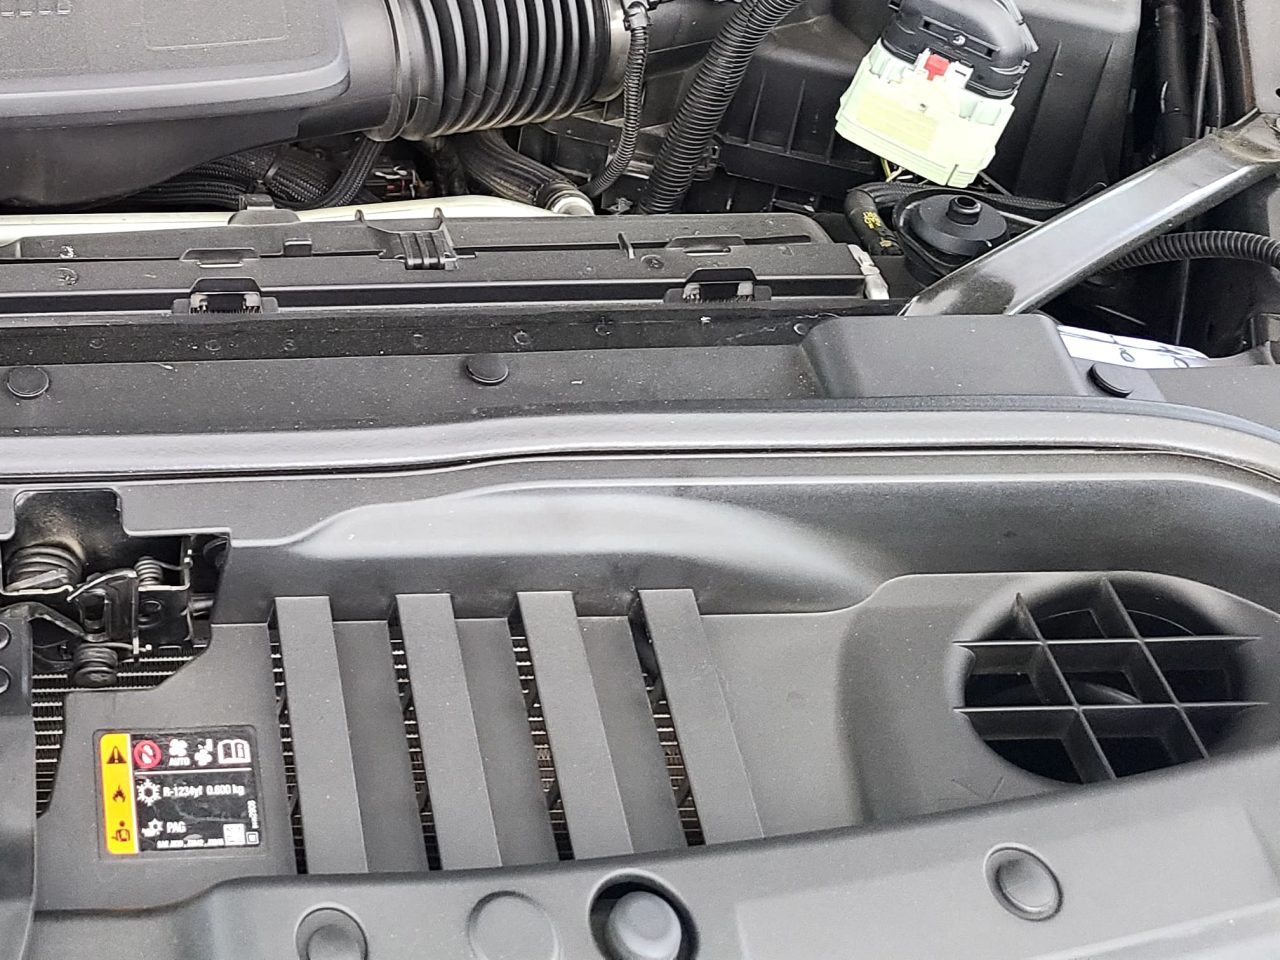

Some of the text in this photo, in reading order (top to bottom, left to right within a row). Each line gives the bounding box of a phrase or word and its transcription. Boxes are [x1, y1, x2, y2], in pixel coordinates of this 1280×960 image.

[168, 757, 191, 766] AUTO
[232, 784, 245, 797] kg
[166, 821, 187, 833] PAG
